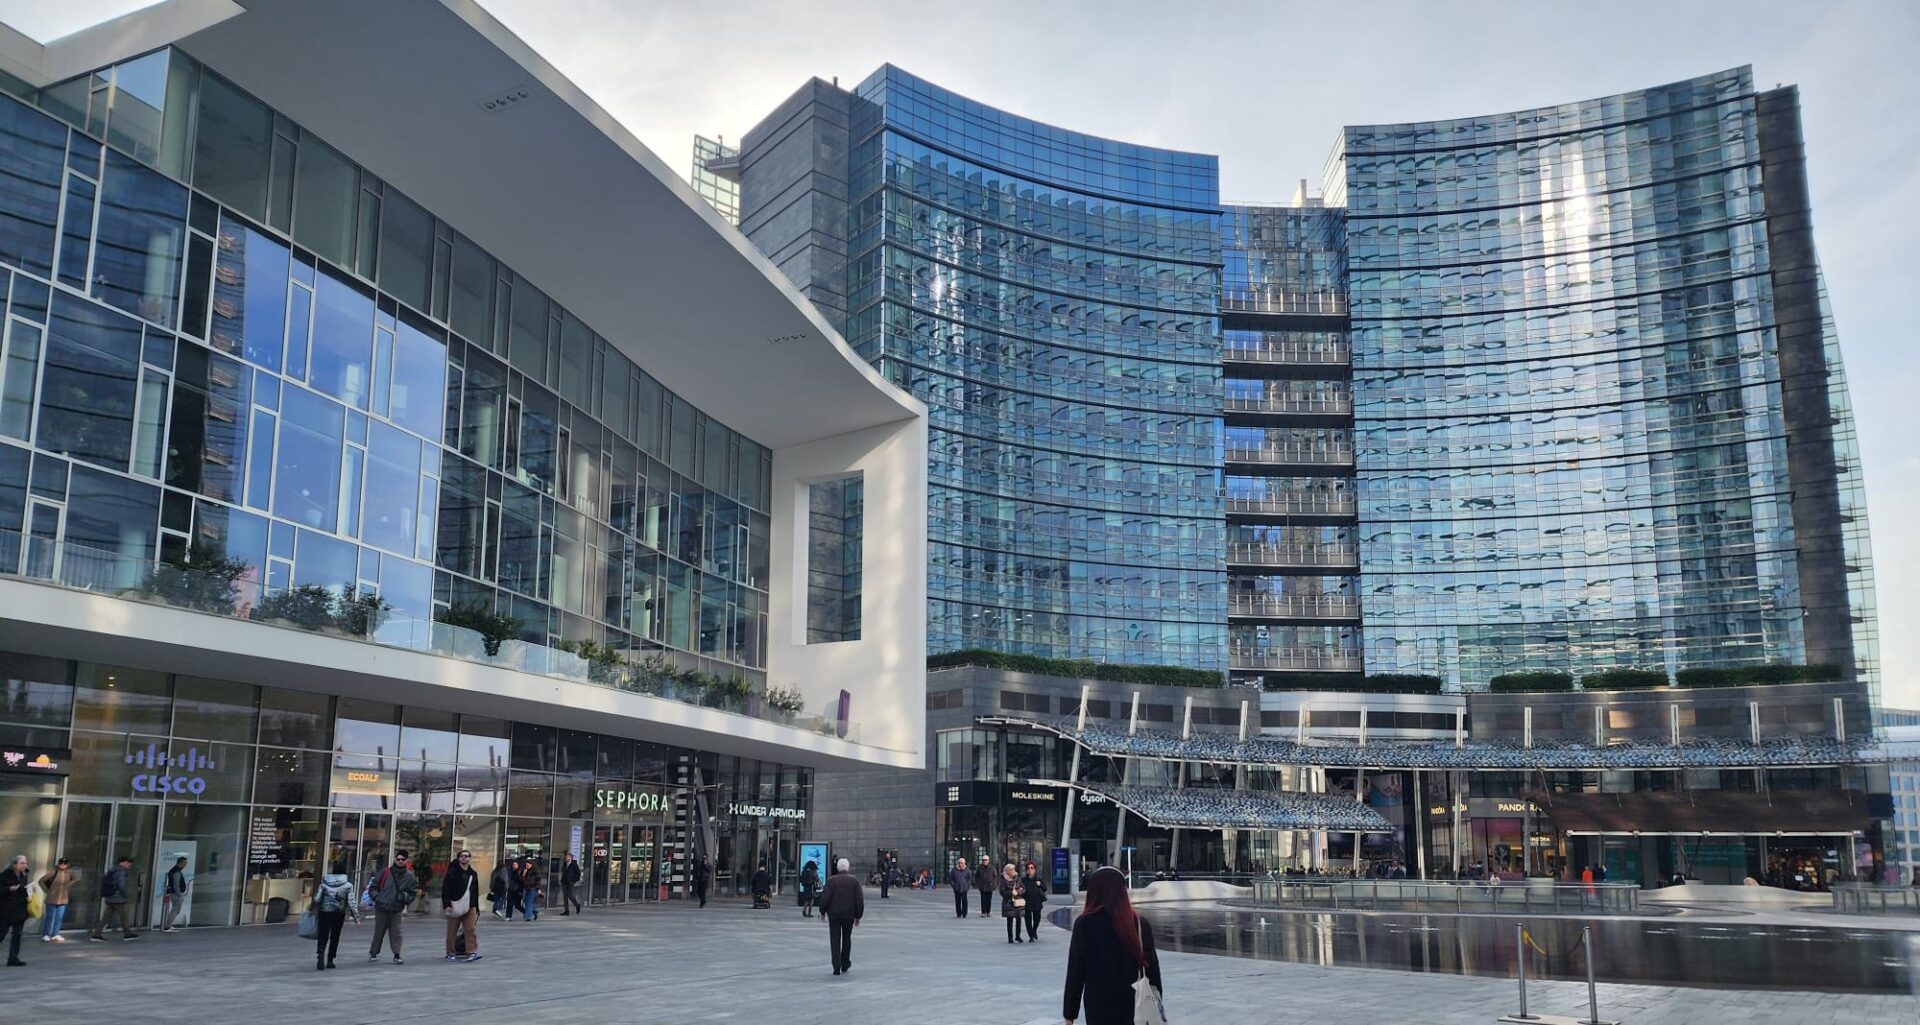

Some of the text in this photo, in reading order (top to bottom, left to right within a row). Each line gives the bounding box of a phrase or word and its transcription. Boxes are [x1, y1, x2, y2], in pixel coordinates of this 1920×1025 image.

[131, 774, 206, 794] CISCO
[347, 772, 379, 782] ECOALF
[596, 789, 668, 811] SEPHORA
[1012, 792, 1055, 800] MOLESKINE
[1080, 788, 1105, 805] dyson
[739, 804, 805, 819] UNDER ARMOUR
